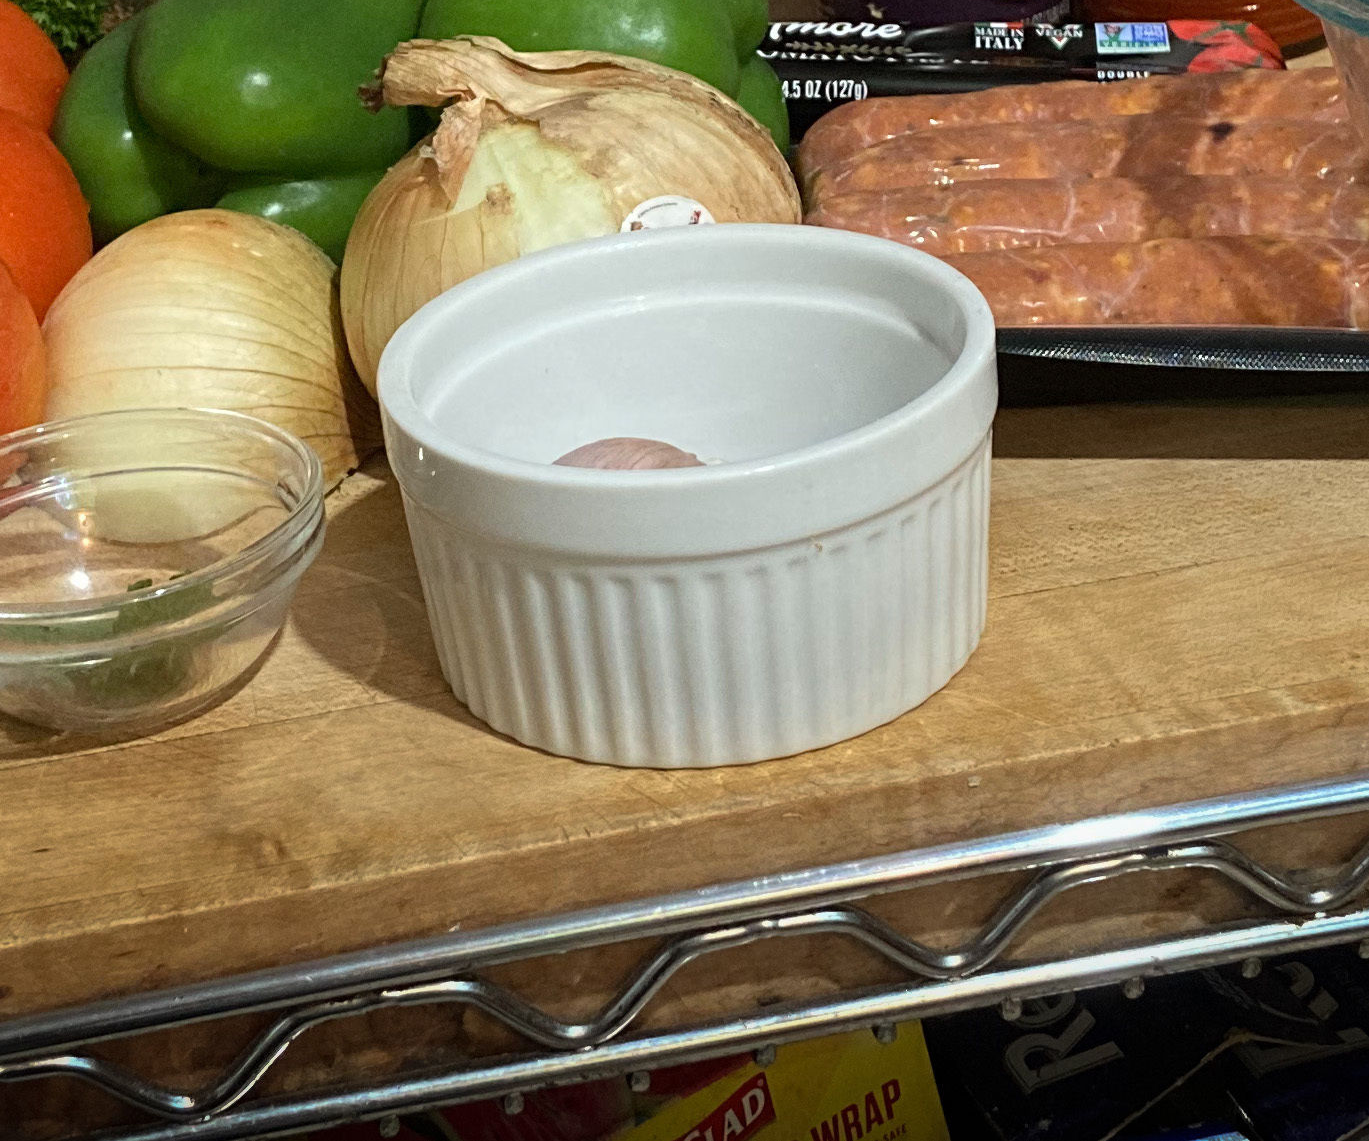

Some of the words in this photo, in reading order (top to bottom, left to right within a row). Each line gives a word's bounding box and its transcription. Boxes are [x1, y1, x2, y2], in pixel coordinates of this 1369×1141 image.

[975, 26, 1008, 37] MADE
[1010, 27, 1025, 37] IN
[1036, 27, 1083, 39] VEGAN
[975, 37, 1024, 51] ITALY
[782, 79, 800, 99] 4.5
[805, 79, 821, 99] OZ
[825, 79, 868, 102] (127g)
[810, 1078, 902, 1141] WRAP
